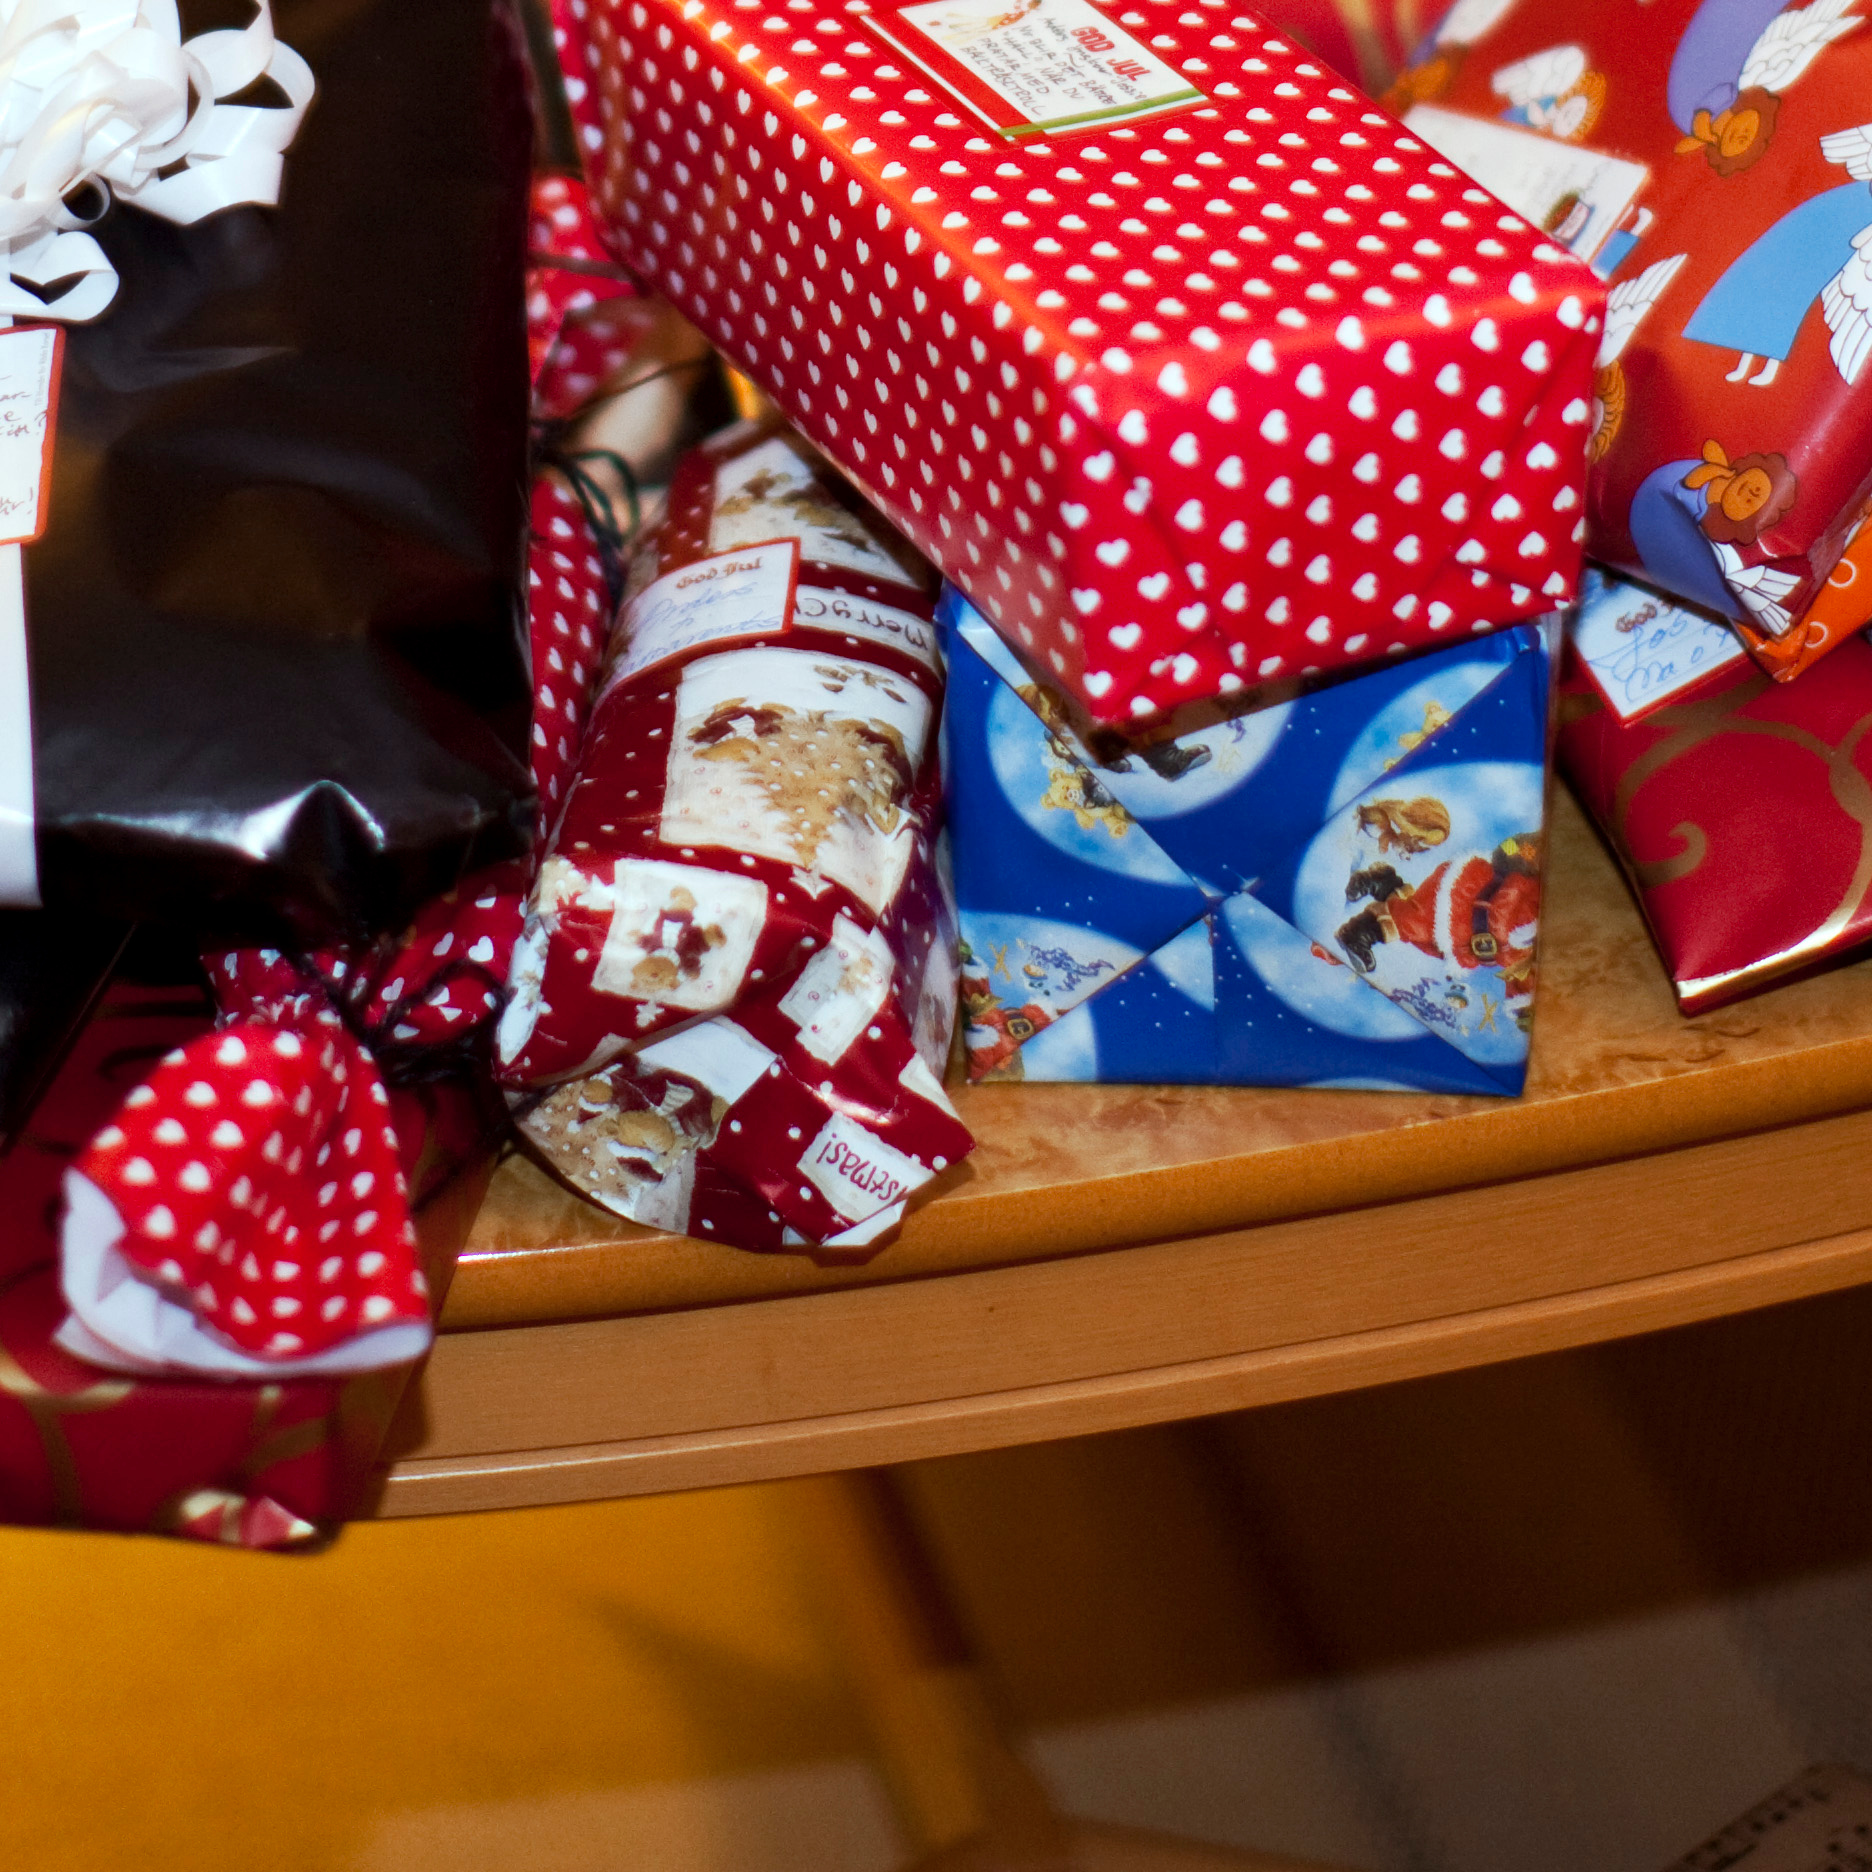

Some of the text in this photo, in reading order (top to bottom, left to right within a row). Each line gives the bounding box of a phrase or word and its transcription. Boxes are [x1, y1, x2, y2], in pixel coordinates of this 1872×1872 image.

[1070, 26, 1152, 82] GOD JUL
[1016, 71, 1050, 94] MED
